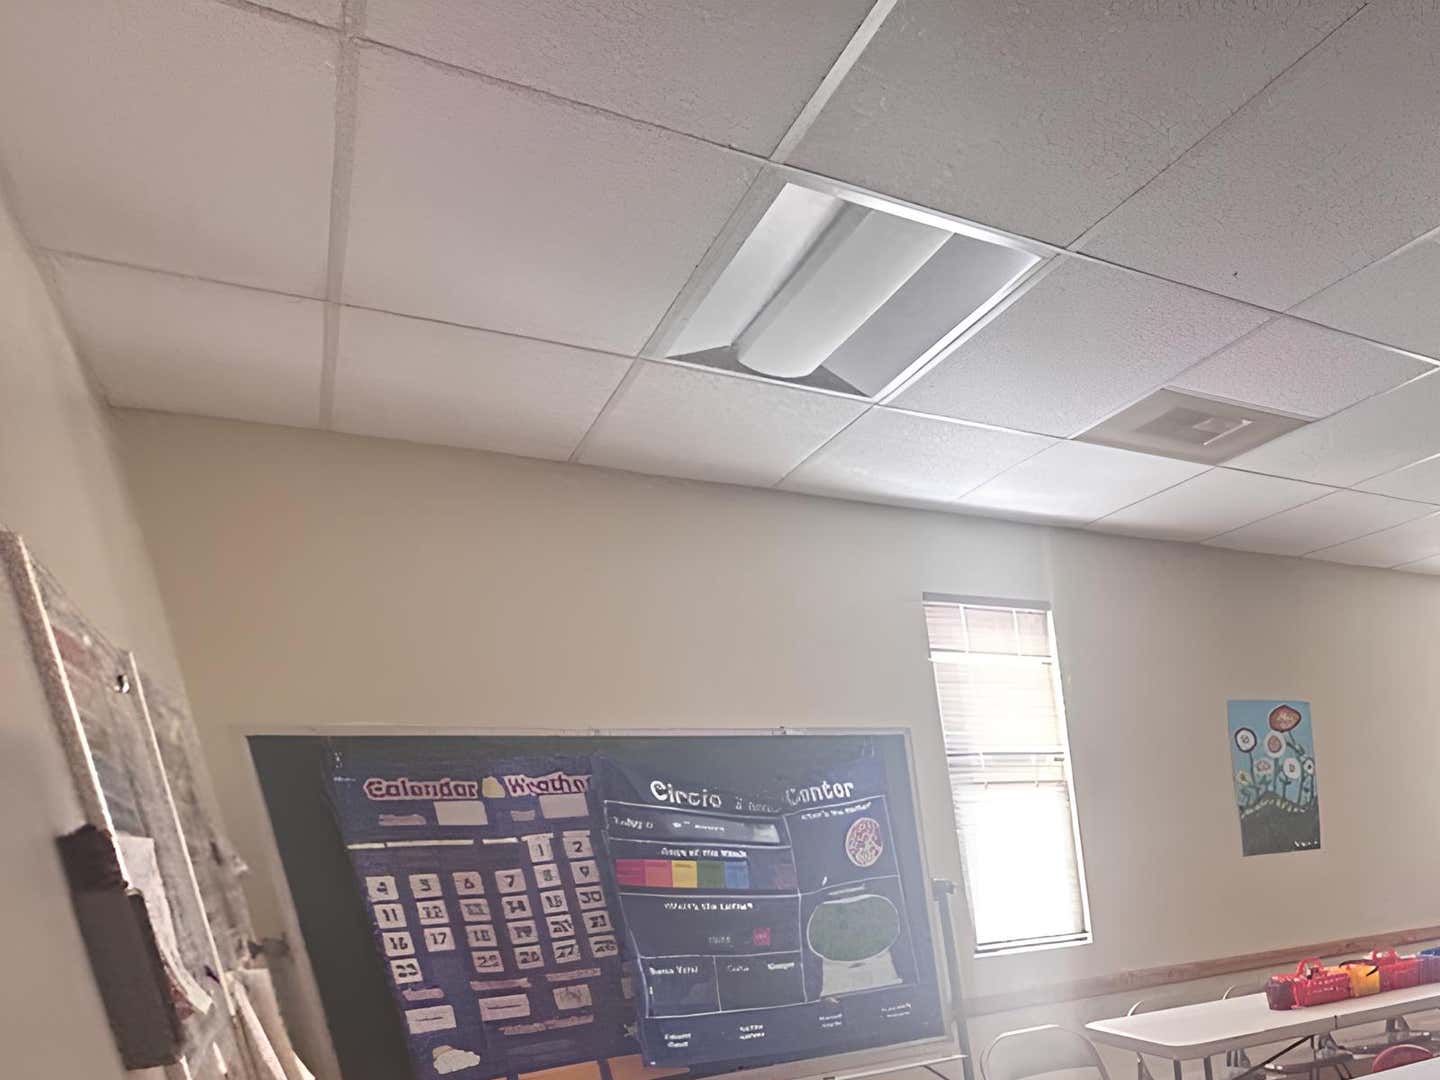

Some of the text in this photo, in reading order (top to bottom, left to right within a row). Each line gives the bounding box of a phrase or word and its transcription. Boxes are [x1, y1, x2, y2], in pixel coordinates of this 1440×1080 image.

[504, 875, 515, 887] 7
[382, 908, 399, 921] 11
[430, 932, 447, 945] 17
